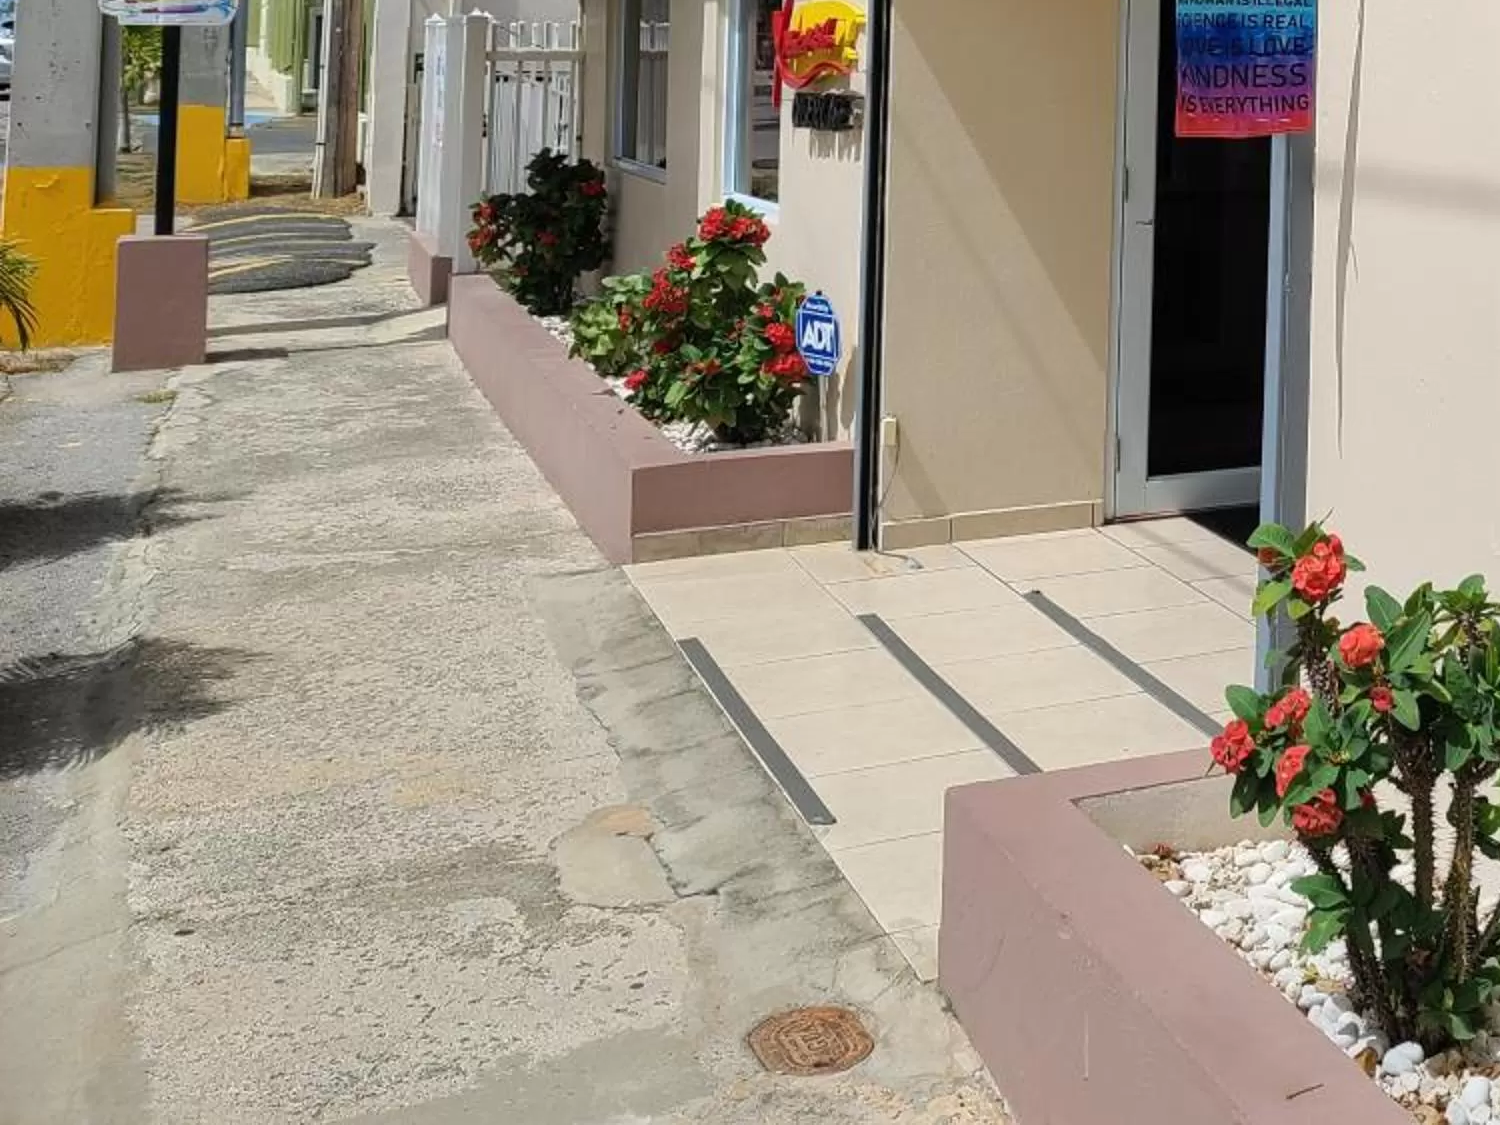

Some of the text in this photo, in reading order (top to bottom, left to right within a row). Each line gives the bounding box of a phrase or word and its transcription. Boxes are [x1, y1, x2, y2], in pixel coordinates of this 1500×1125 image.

[1241, 13, 1258, 29] IS
[1263, 14, 1306, 30] REAL
[1249, 35, 1308, 57] LOVE
[1181, 93, 1310, 114] IS EVERYTHING
[801, 319, 835, 353] ADT
